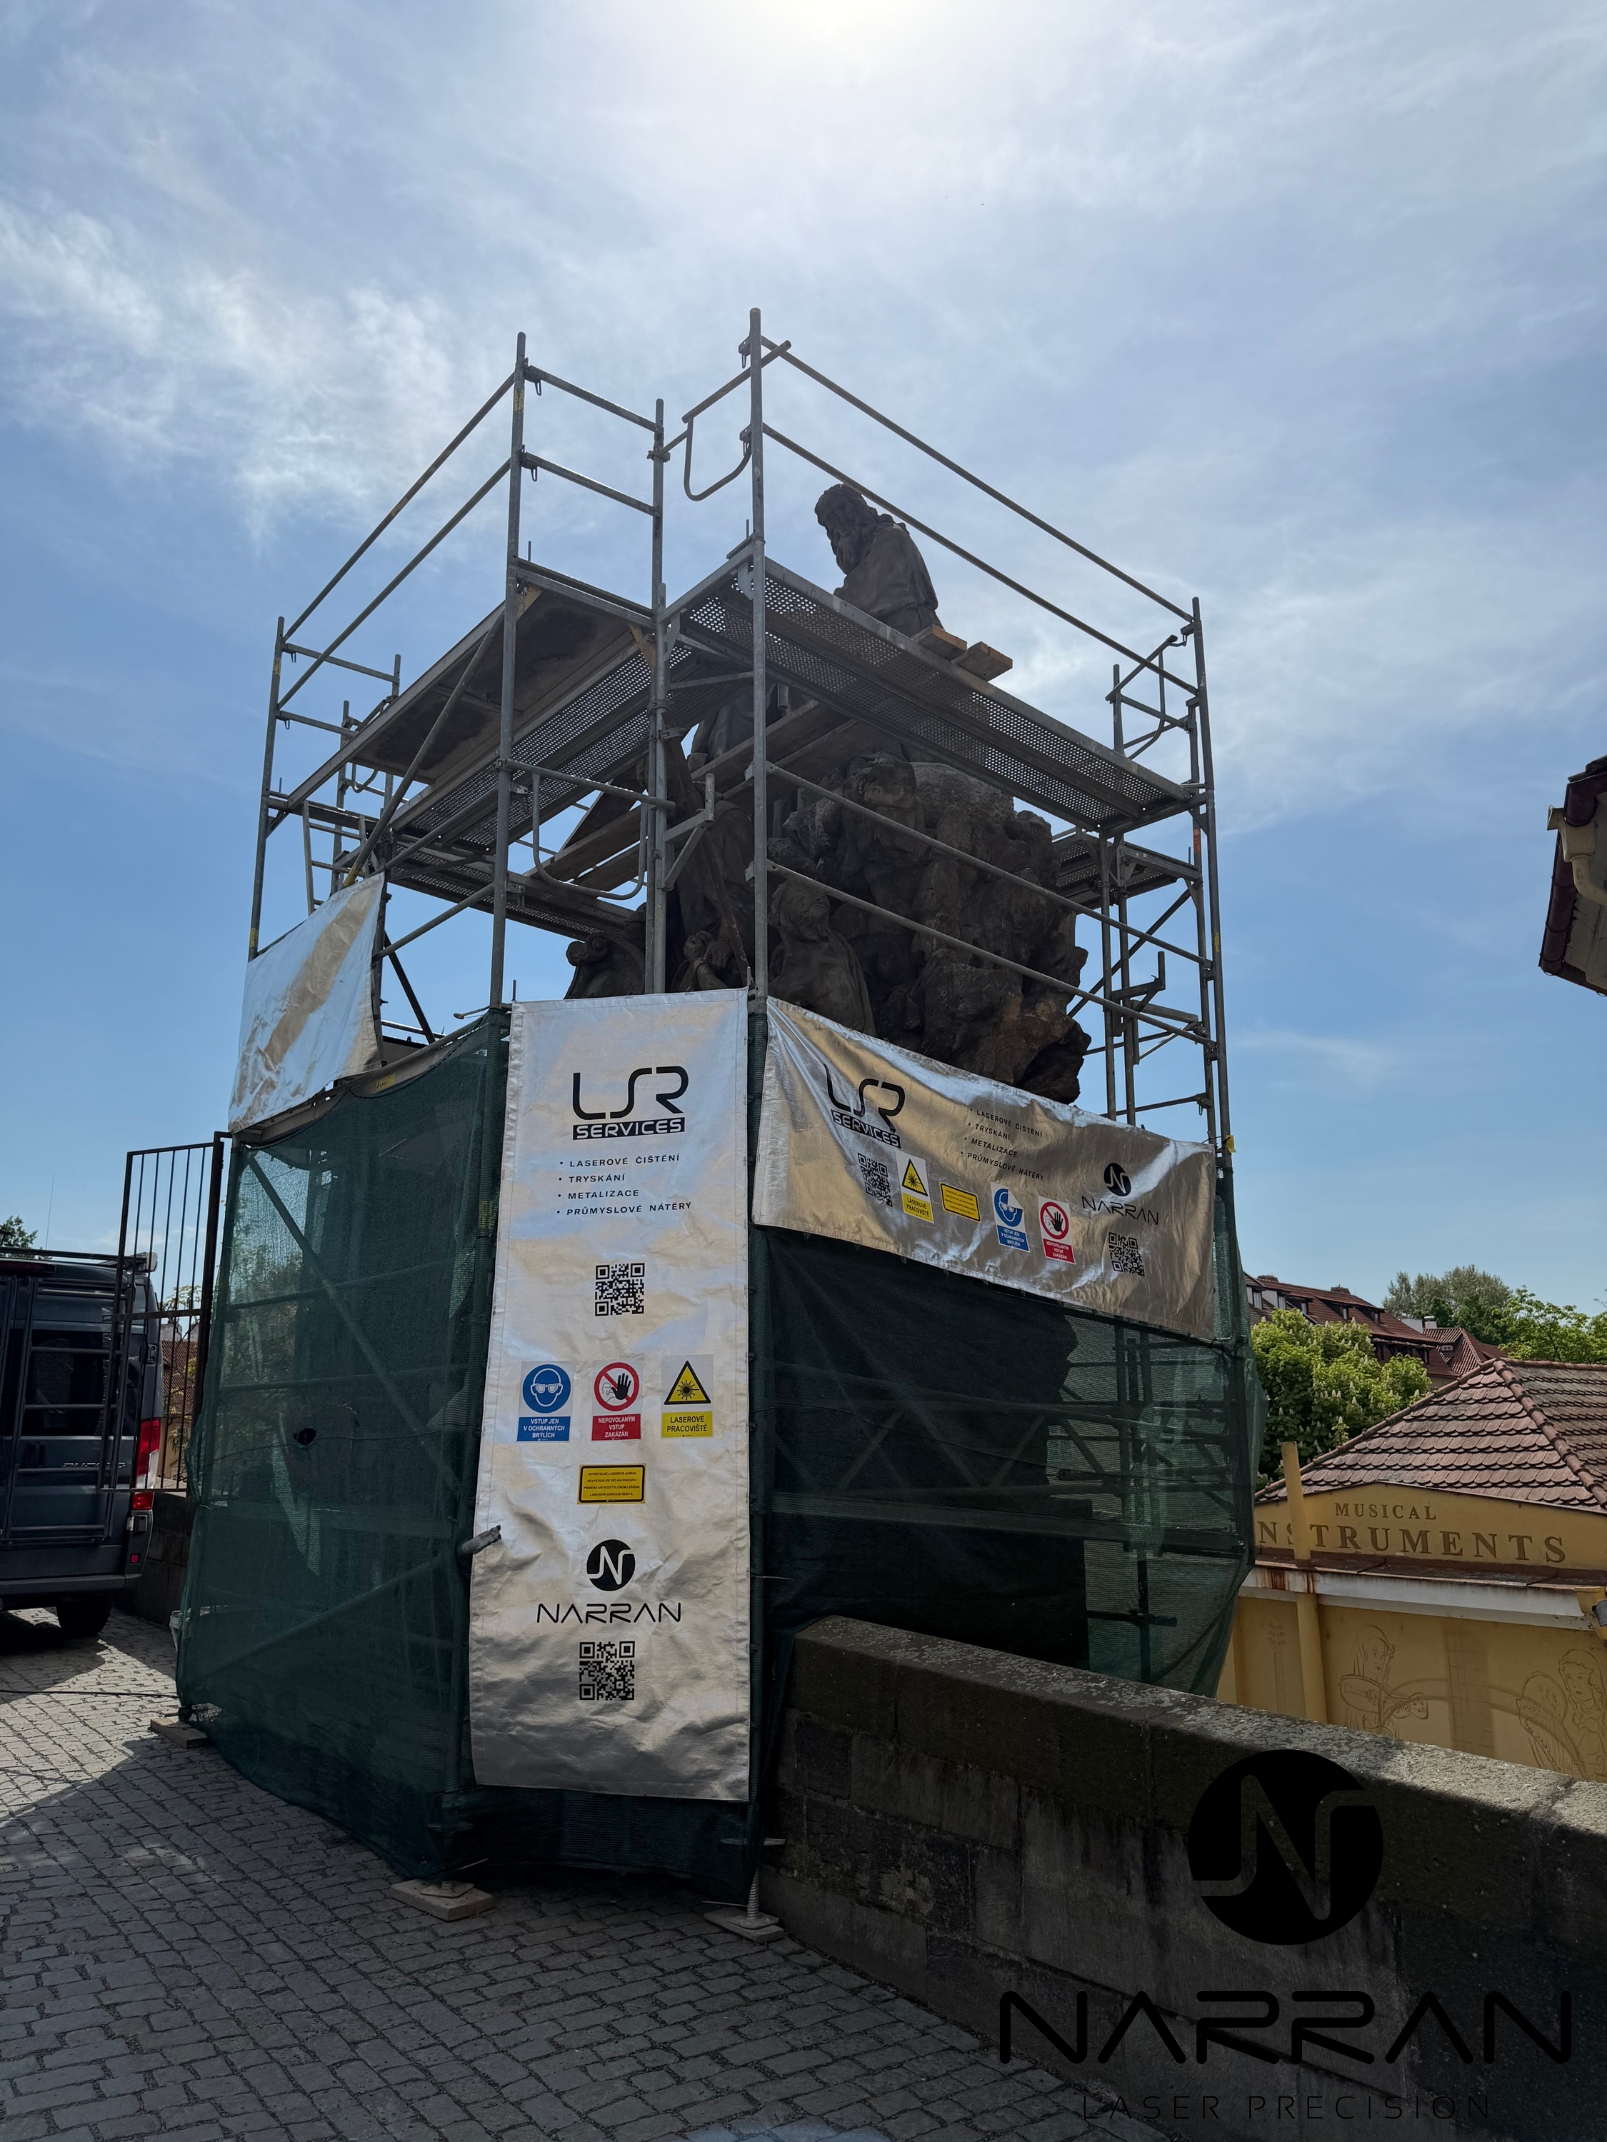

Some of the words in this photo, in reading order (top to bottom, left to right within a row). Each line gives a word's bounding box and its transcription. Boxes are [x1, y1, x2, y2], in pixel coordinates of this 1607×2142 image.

[573, 1066, 689, 1120] LSR
[976, 1109, 1012, 1127] LASEROVÉ
[576, 1119, 682, 1139] SERVICES
[832, 1111, 899, 1147] SERVICES
[970, 1138, 1018, 1157] METALIZACE
[569, 1157, 629, 1168] LASEROVÉ
[568, 1173, 626, 1183] TRYSKÁNÍ
[567, 1189, 639, 1200] METALIZACE
[566, 1205, 642, 1215] PRŮMYSLOVÉ
[1081, 1196, 1159, 1225] NARRAN
[670, 1414, 705, 1424] LASEROVÉ
[1334, 1502, 1437, 1520] MUSICAL
[1257, 1521, 1566, 1563] NTRUMENTS
[536, 1602, 681, 1624] NARRAN
